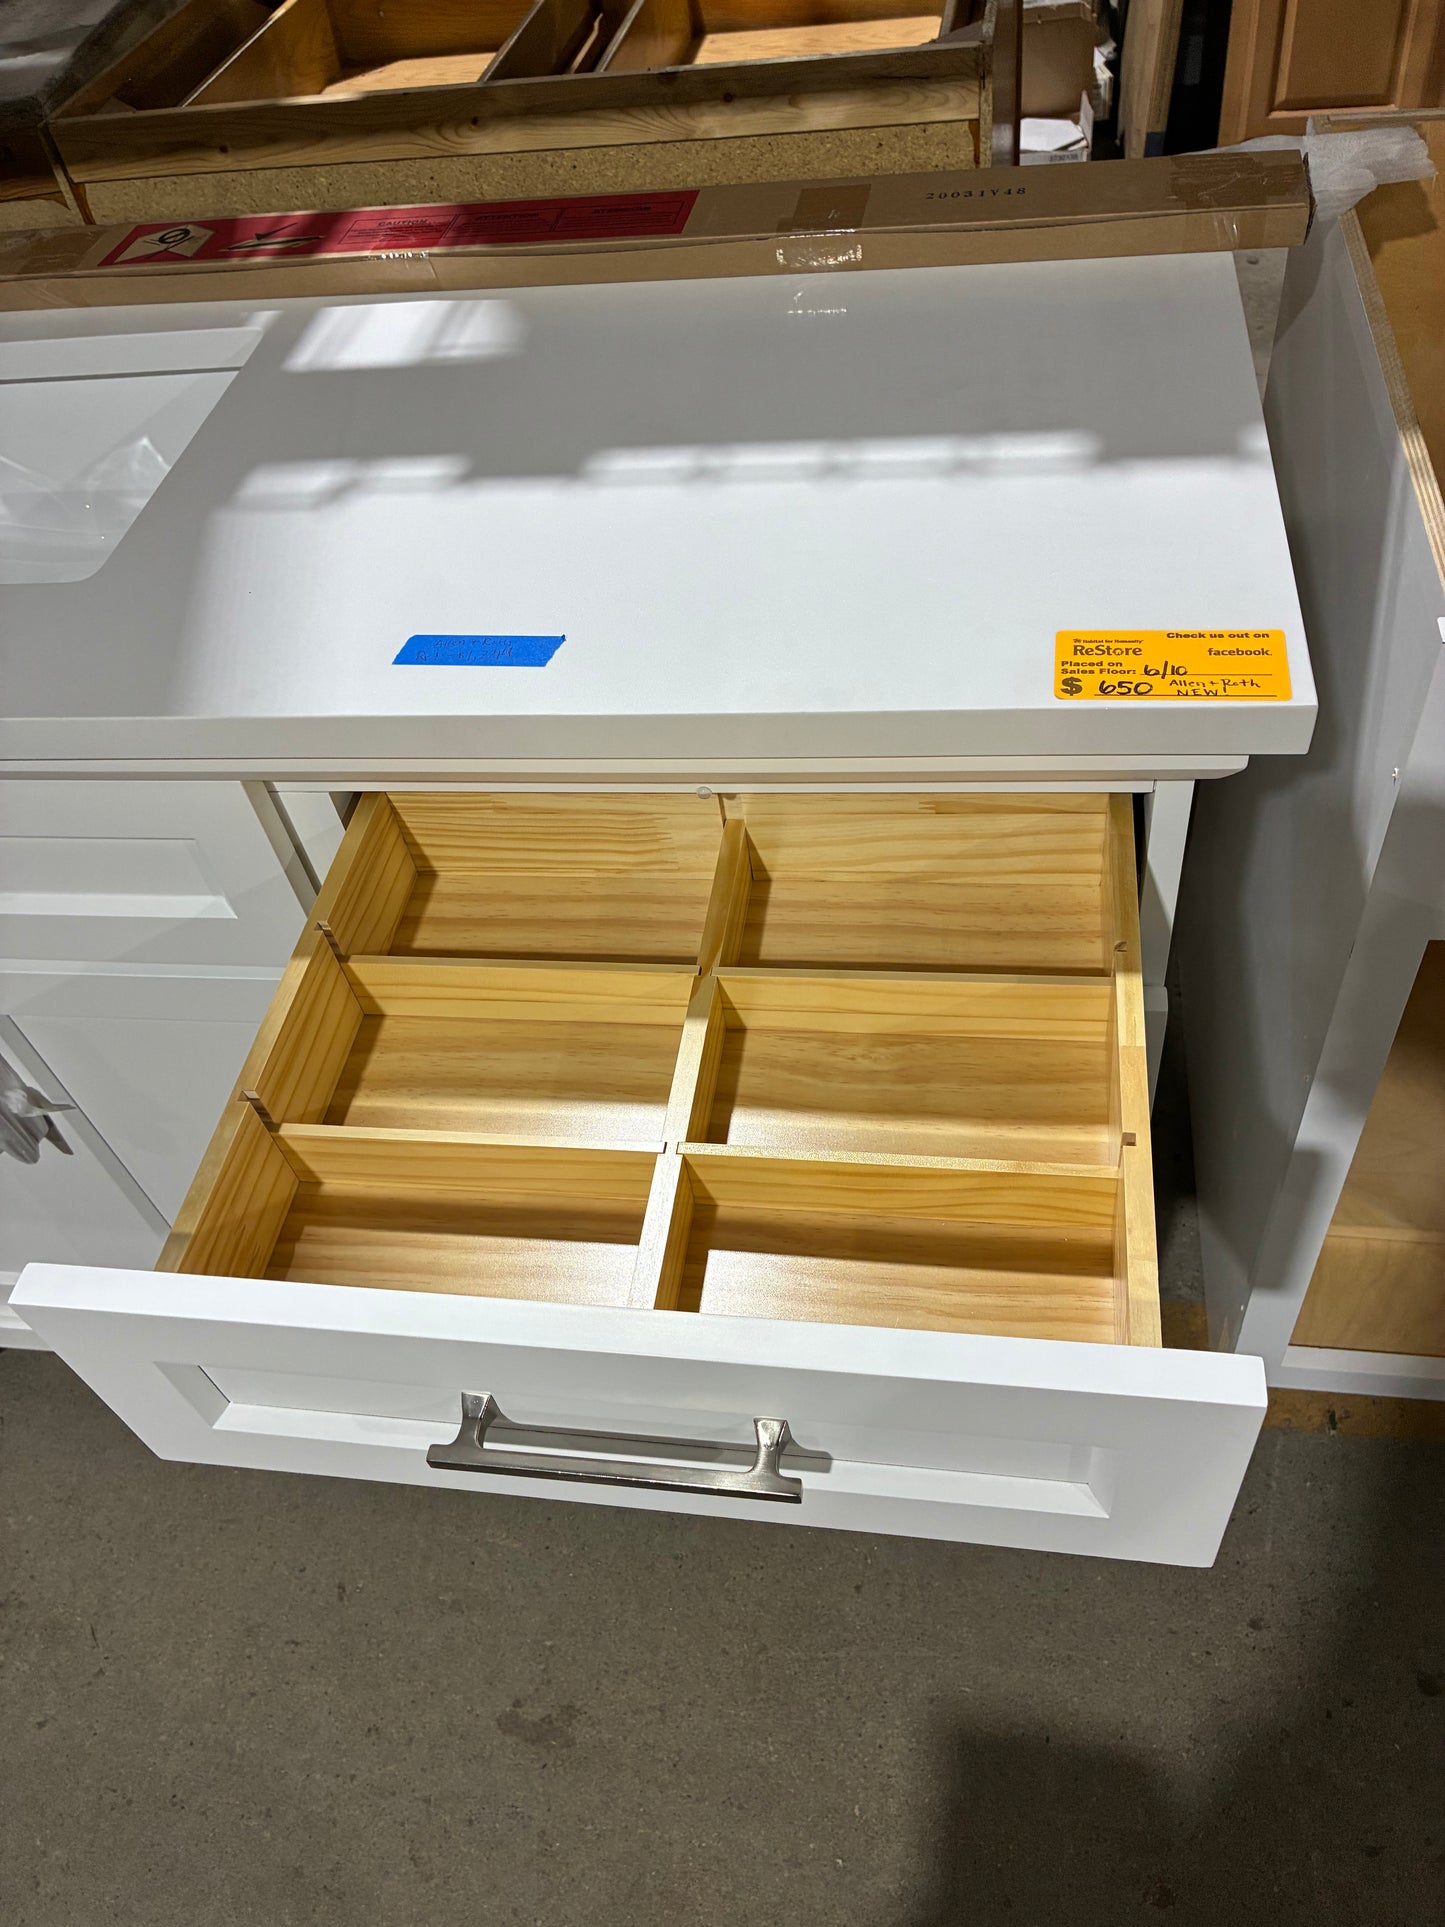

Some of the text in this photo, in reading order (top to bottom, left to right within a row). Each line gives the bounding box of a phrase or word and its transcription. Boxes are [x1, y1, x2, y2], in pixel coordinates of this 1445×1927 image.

[1073, 644, 1143, 656] ReStore
[1143, 660, 1188, 680] 6/10
[1060, 676, 1154, 697] $ 650
[1169, 679, 1206, 688] Allen
[1176, 686, 1230, 697] NEW!
